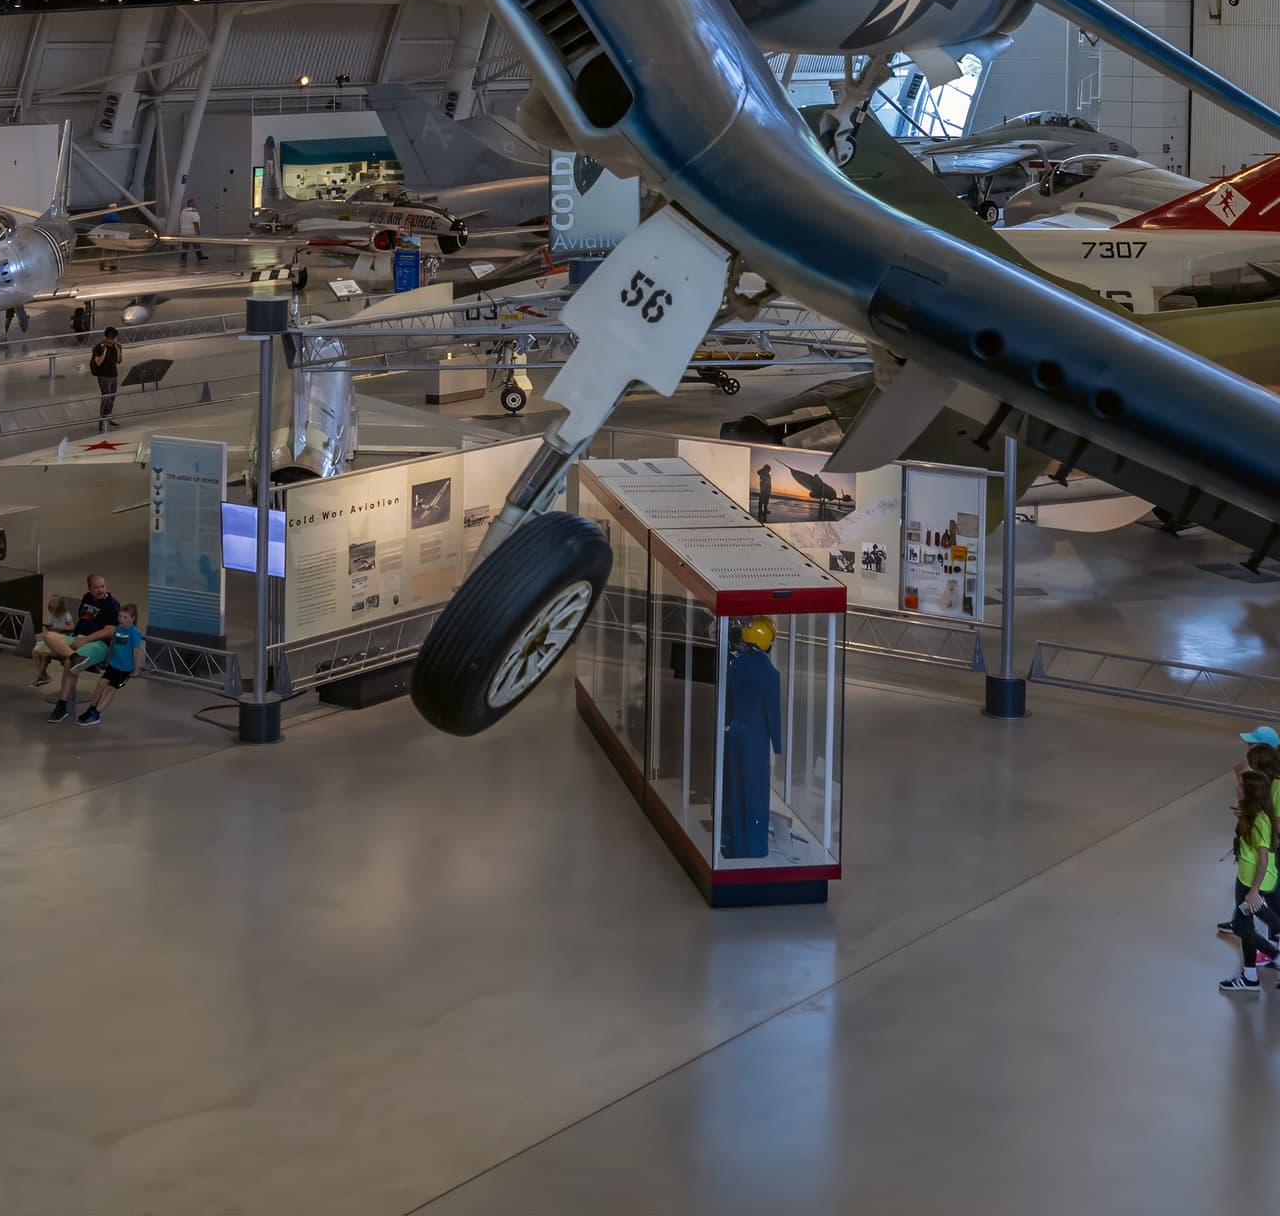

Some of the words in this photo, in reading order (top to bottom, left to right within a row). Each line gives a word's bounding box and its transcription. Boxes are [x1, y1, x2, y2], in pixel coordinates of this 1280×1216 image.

[551, 156, 575, 231] COLD
[386, 211, 403, 225] AIR
[1081, 241, 1148, 259] 7307
[620, 269, 673, 324] 56
[288, 514, 315, 528] Cold
[321, 508, 344, 521] War
[350, 497, 400, 515] Aviation
